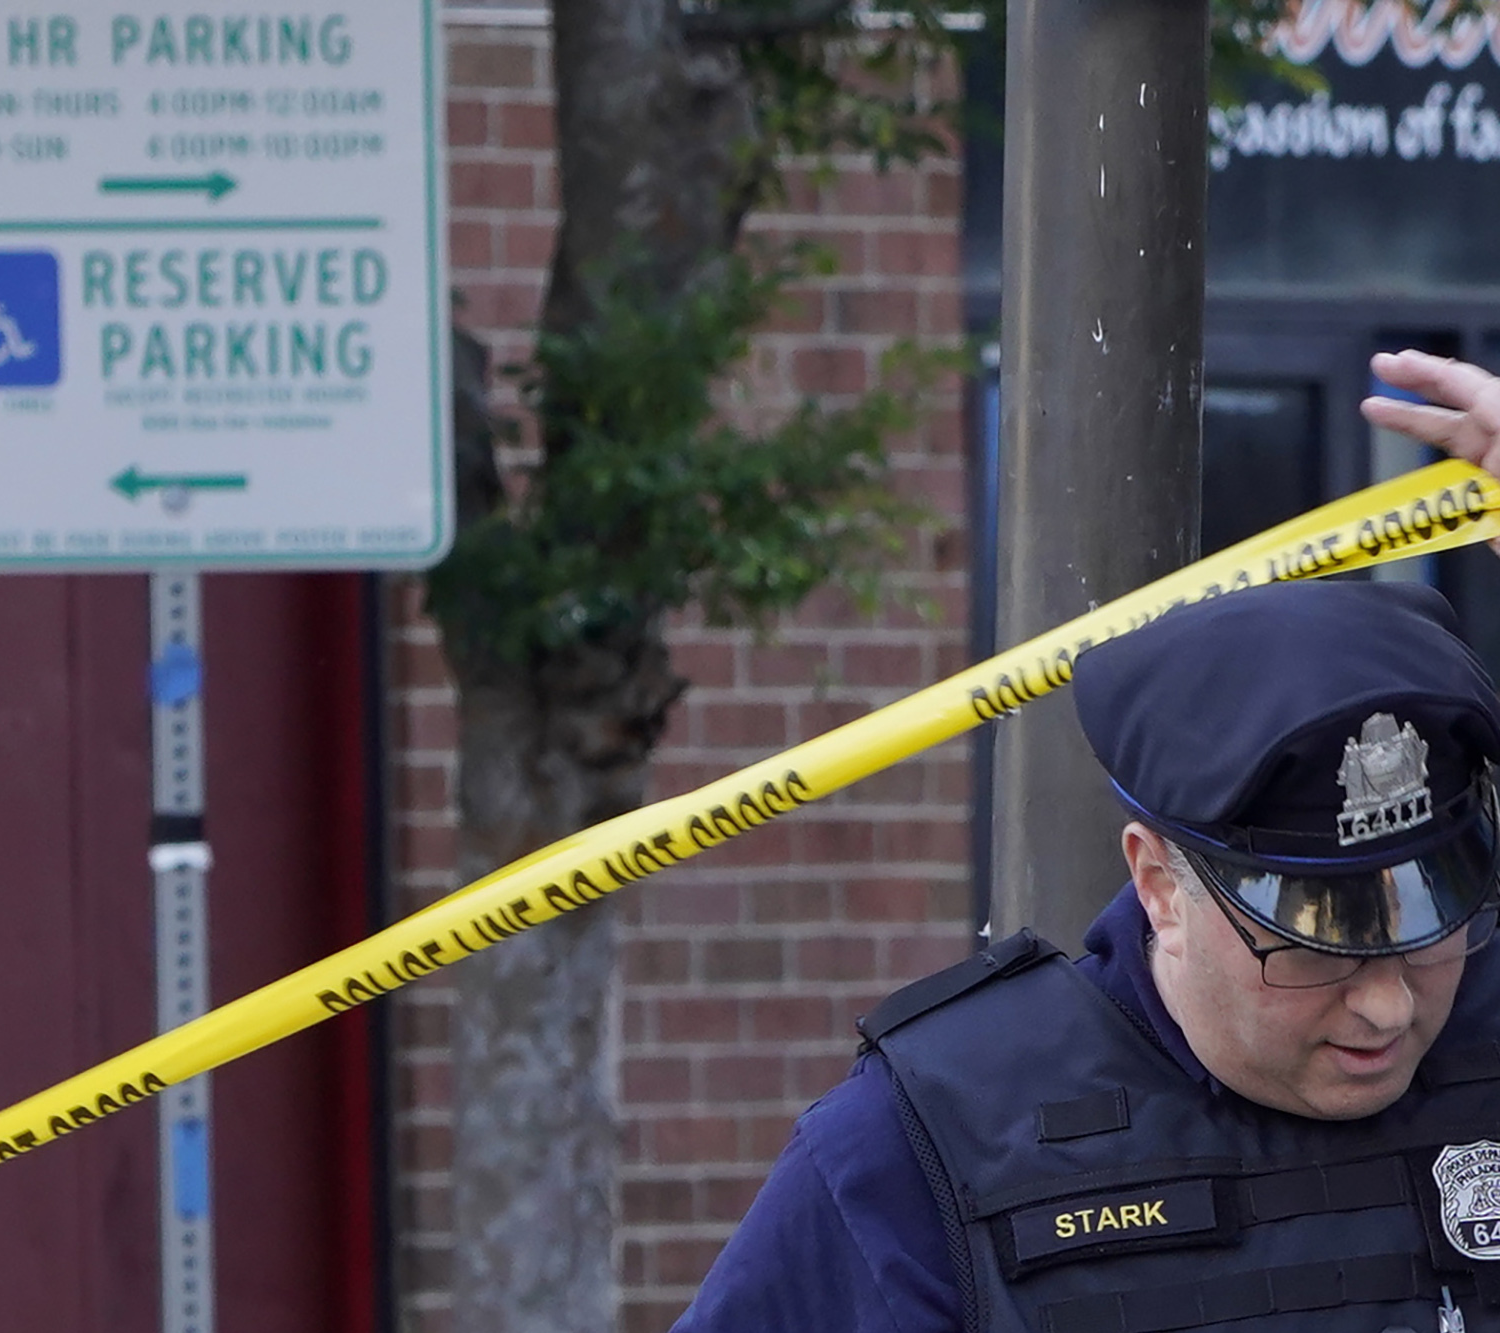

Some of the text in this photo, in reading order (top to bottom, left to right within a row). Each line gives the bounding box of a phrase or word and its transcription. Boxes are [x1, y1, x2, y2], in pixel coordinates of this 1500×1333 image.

[7, 15, 79, 66] HR
[110, 14, 354, 66] PARKING
[1396, 82, 1452, 161] of
[82, 248, 388, 308] RESERVED
[101, 320, 373, 380] PARKING
[1350, 798, 1418, 840] 6411
[1446, 1153, 1475, 1173] POLICE
[1055, 1200, 1168, 1238] STARK
